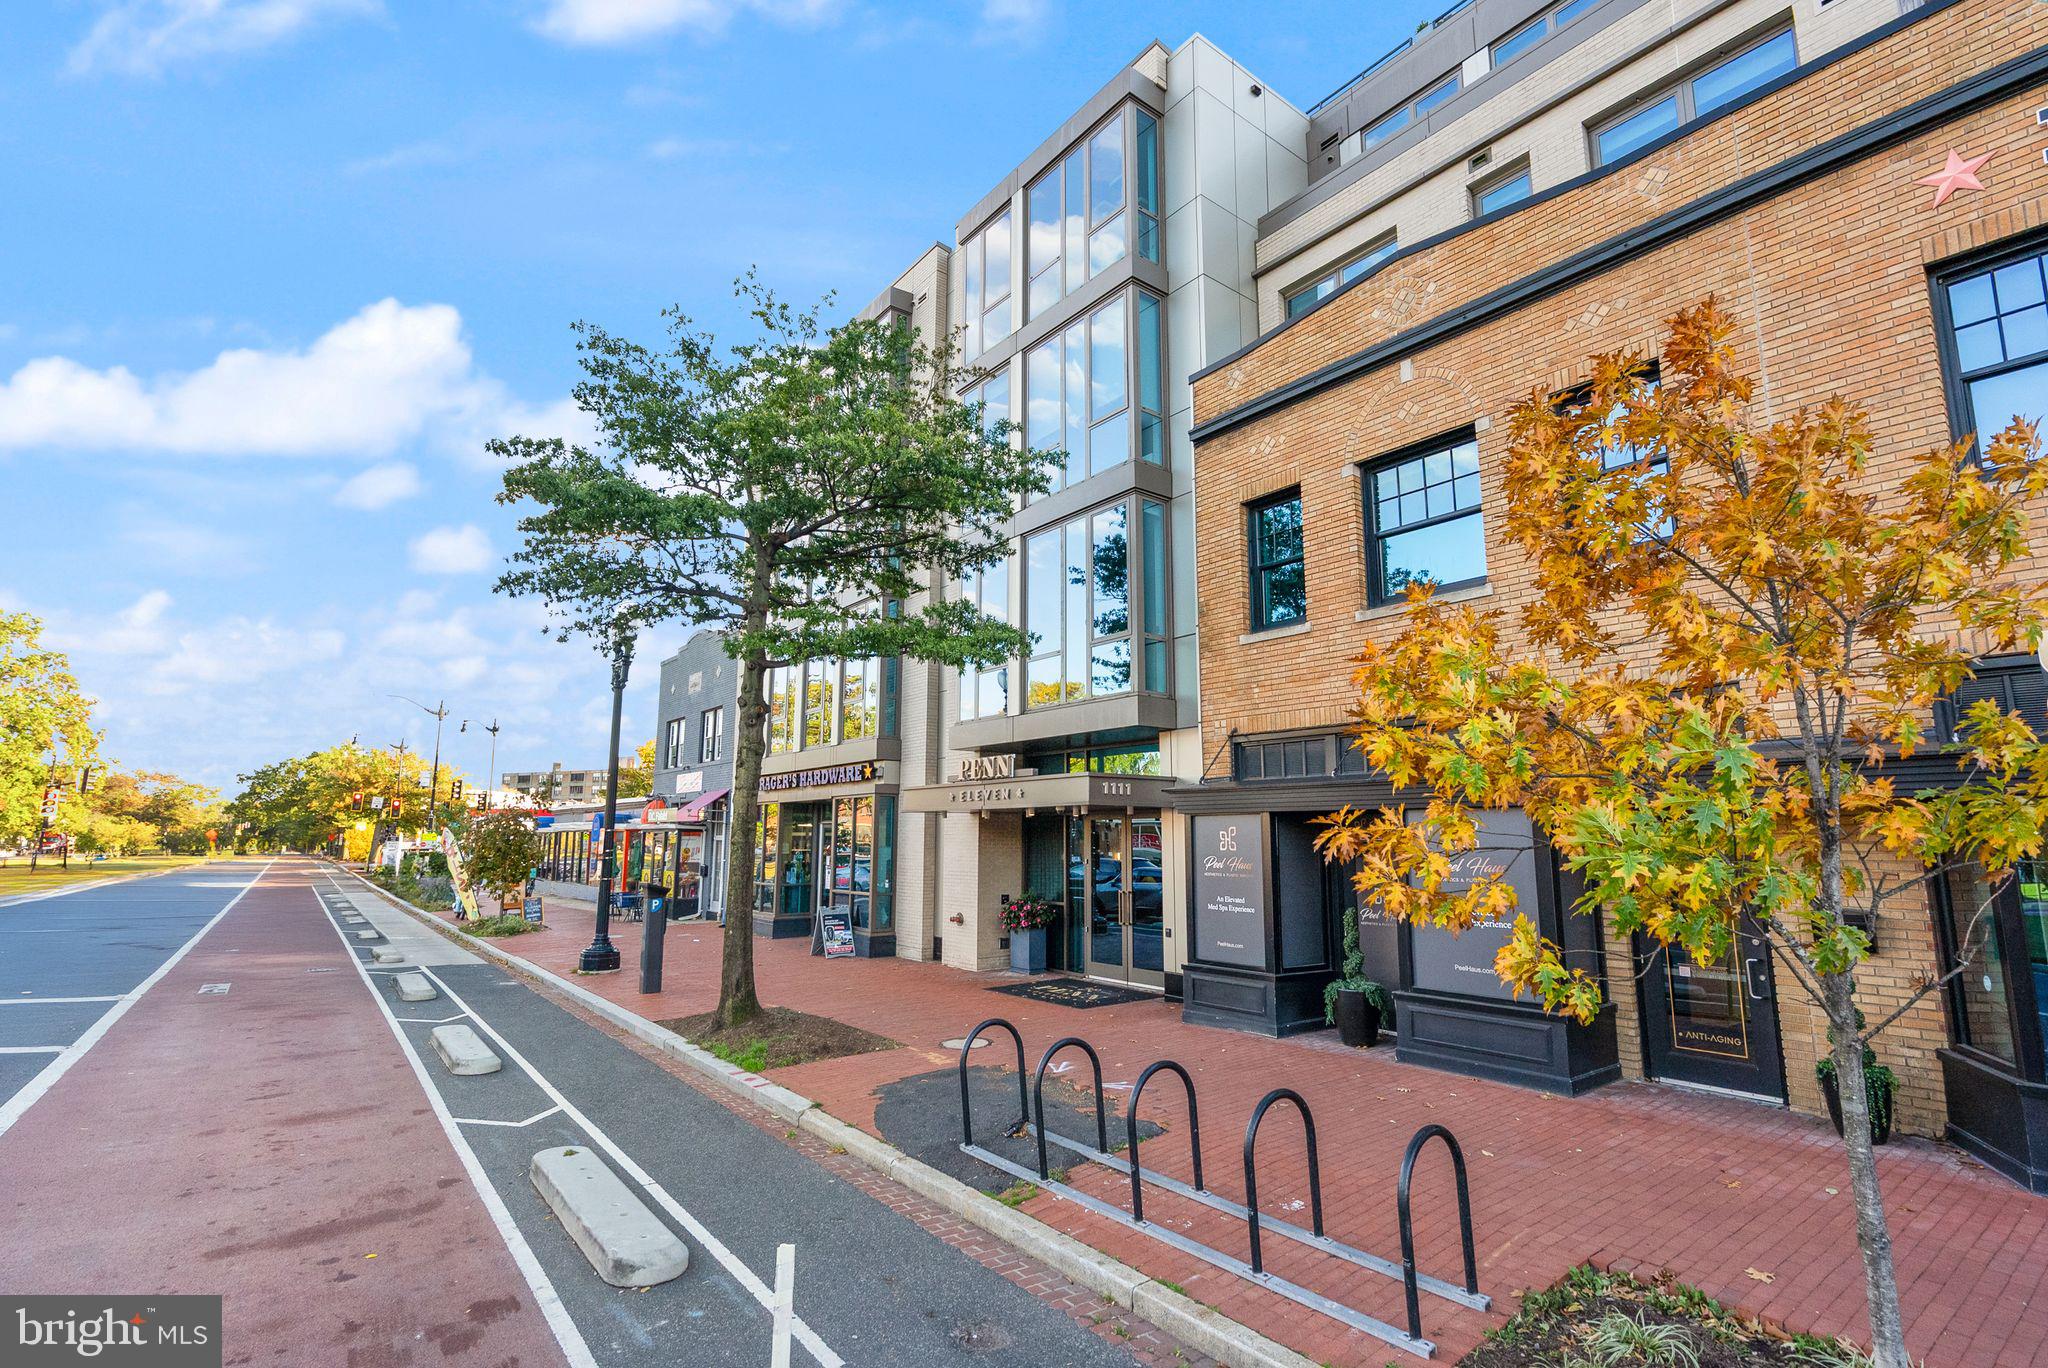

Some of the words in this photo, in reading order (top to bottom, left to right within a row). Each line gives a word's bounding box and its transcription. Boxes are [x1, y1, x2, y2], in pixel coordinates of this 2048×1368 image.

[958, 754, 1016, 781] PENN
[759, 772, 797, 791] RAGER'S
[800, 765, 862, 787] HARDWARE
[1102, 782, 1132, 795] 1111
[961, 789, 1011, 802] ELEVEN
[1203, 856, 1227, 871] Peel
[1447, 858, 1465, 872] eel
[1224, 895, 1246, 904] Elevated
[1218, 904, 1228, 912] Spa
[1228, 904, 1256, 914] Experience
[1360, 908, 1382, 921] Peel
[1454, 964, 1496, 975] PeelHaus.com
[1685, 1032, 1742, 1046] ANTI-AGING
